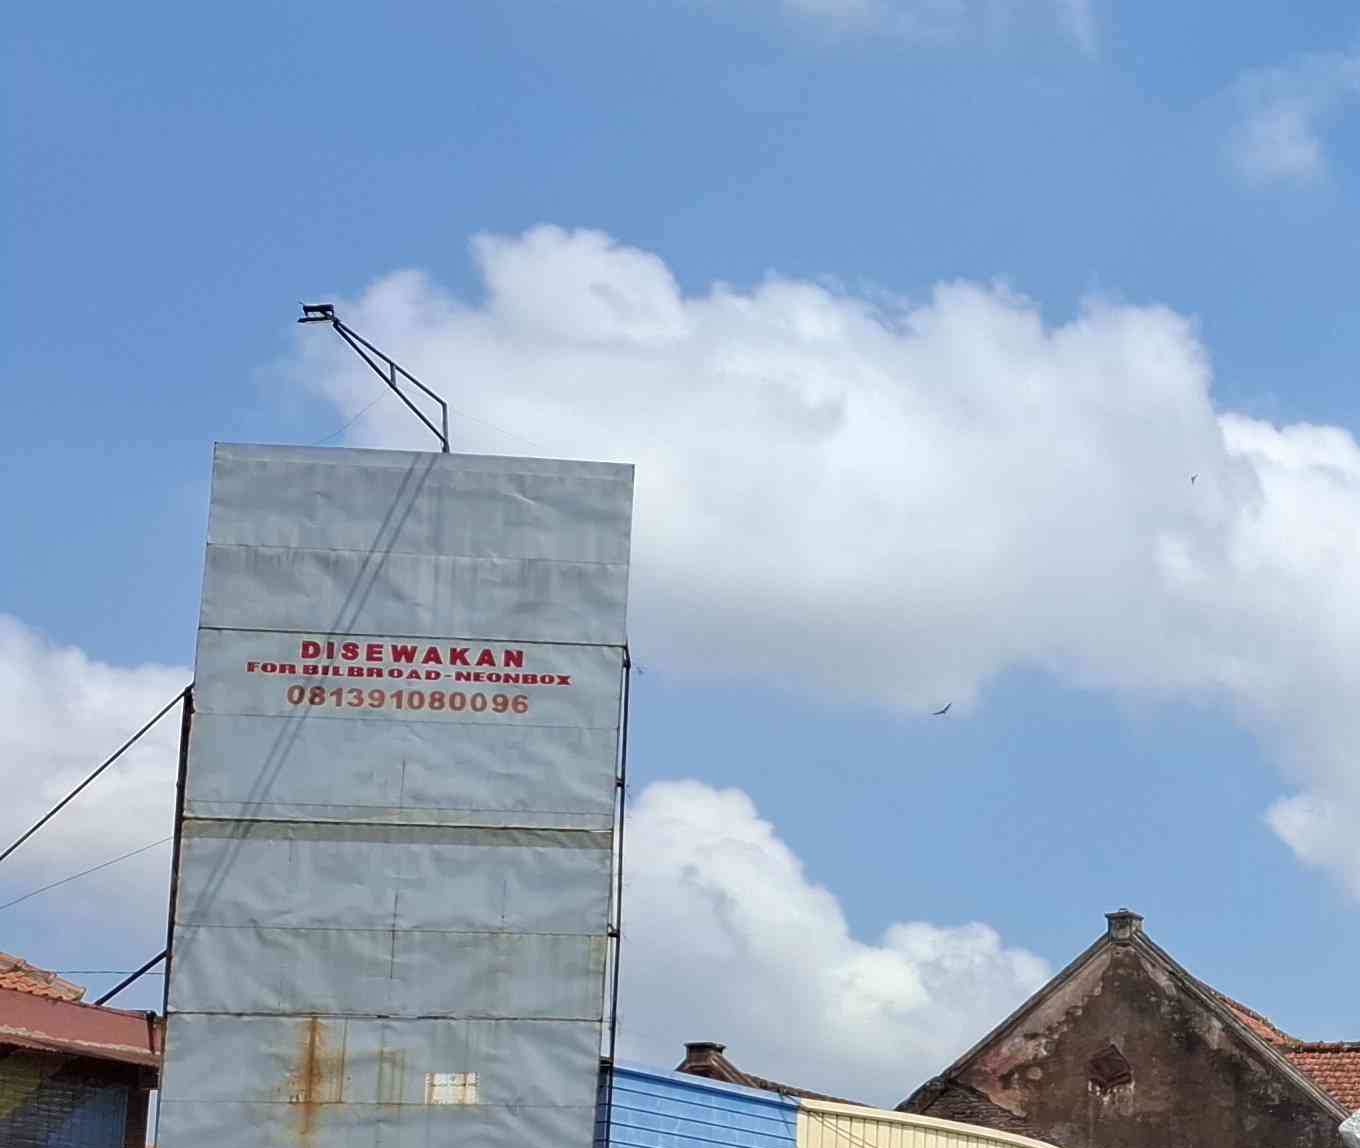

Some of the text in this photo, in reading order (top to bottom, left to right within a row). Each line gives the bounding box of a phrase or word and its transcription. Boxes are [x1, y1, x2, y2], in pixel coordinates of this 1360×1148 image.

[246, 661, 297, 675] FOR
[301, 640, 525, 668] DISEWAKAN
[286, 684, 530, 714] 081391080096
